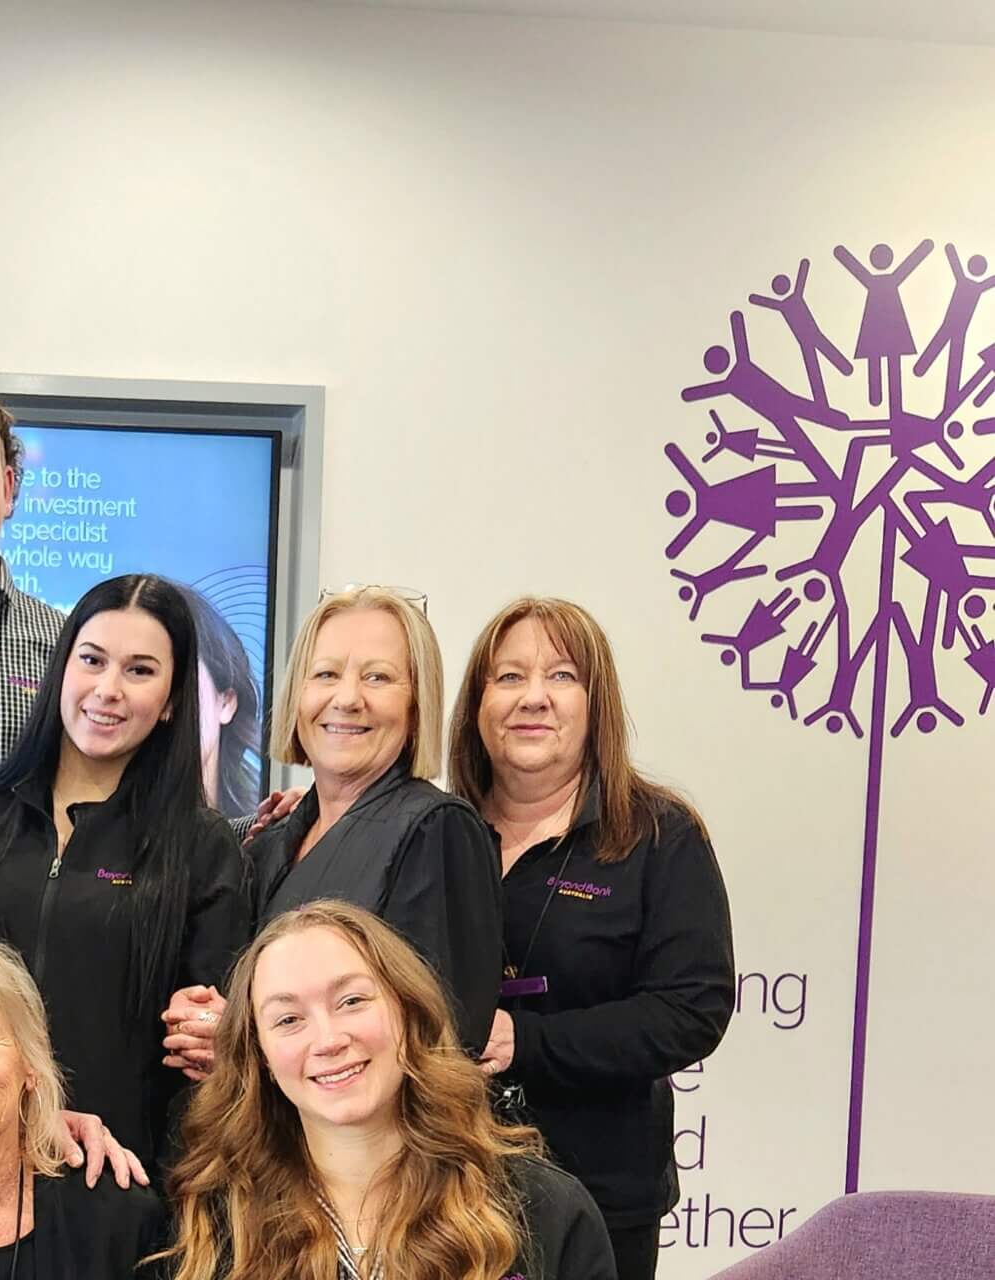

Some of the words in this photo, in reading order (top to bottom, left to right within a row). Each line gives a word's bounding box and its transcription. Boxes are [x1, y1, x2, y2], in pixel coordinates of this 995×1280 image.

[41, 467, 62, 488] to
[68, 468, 101, 489] the
[24, 494, 137, 518] investment
[11, 521, 107, 544] specialist
[0, 545, 63, 568] whole
[68, 550, 113, 575] way
